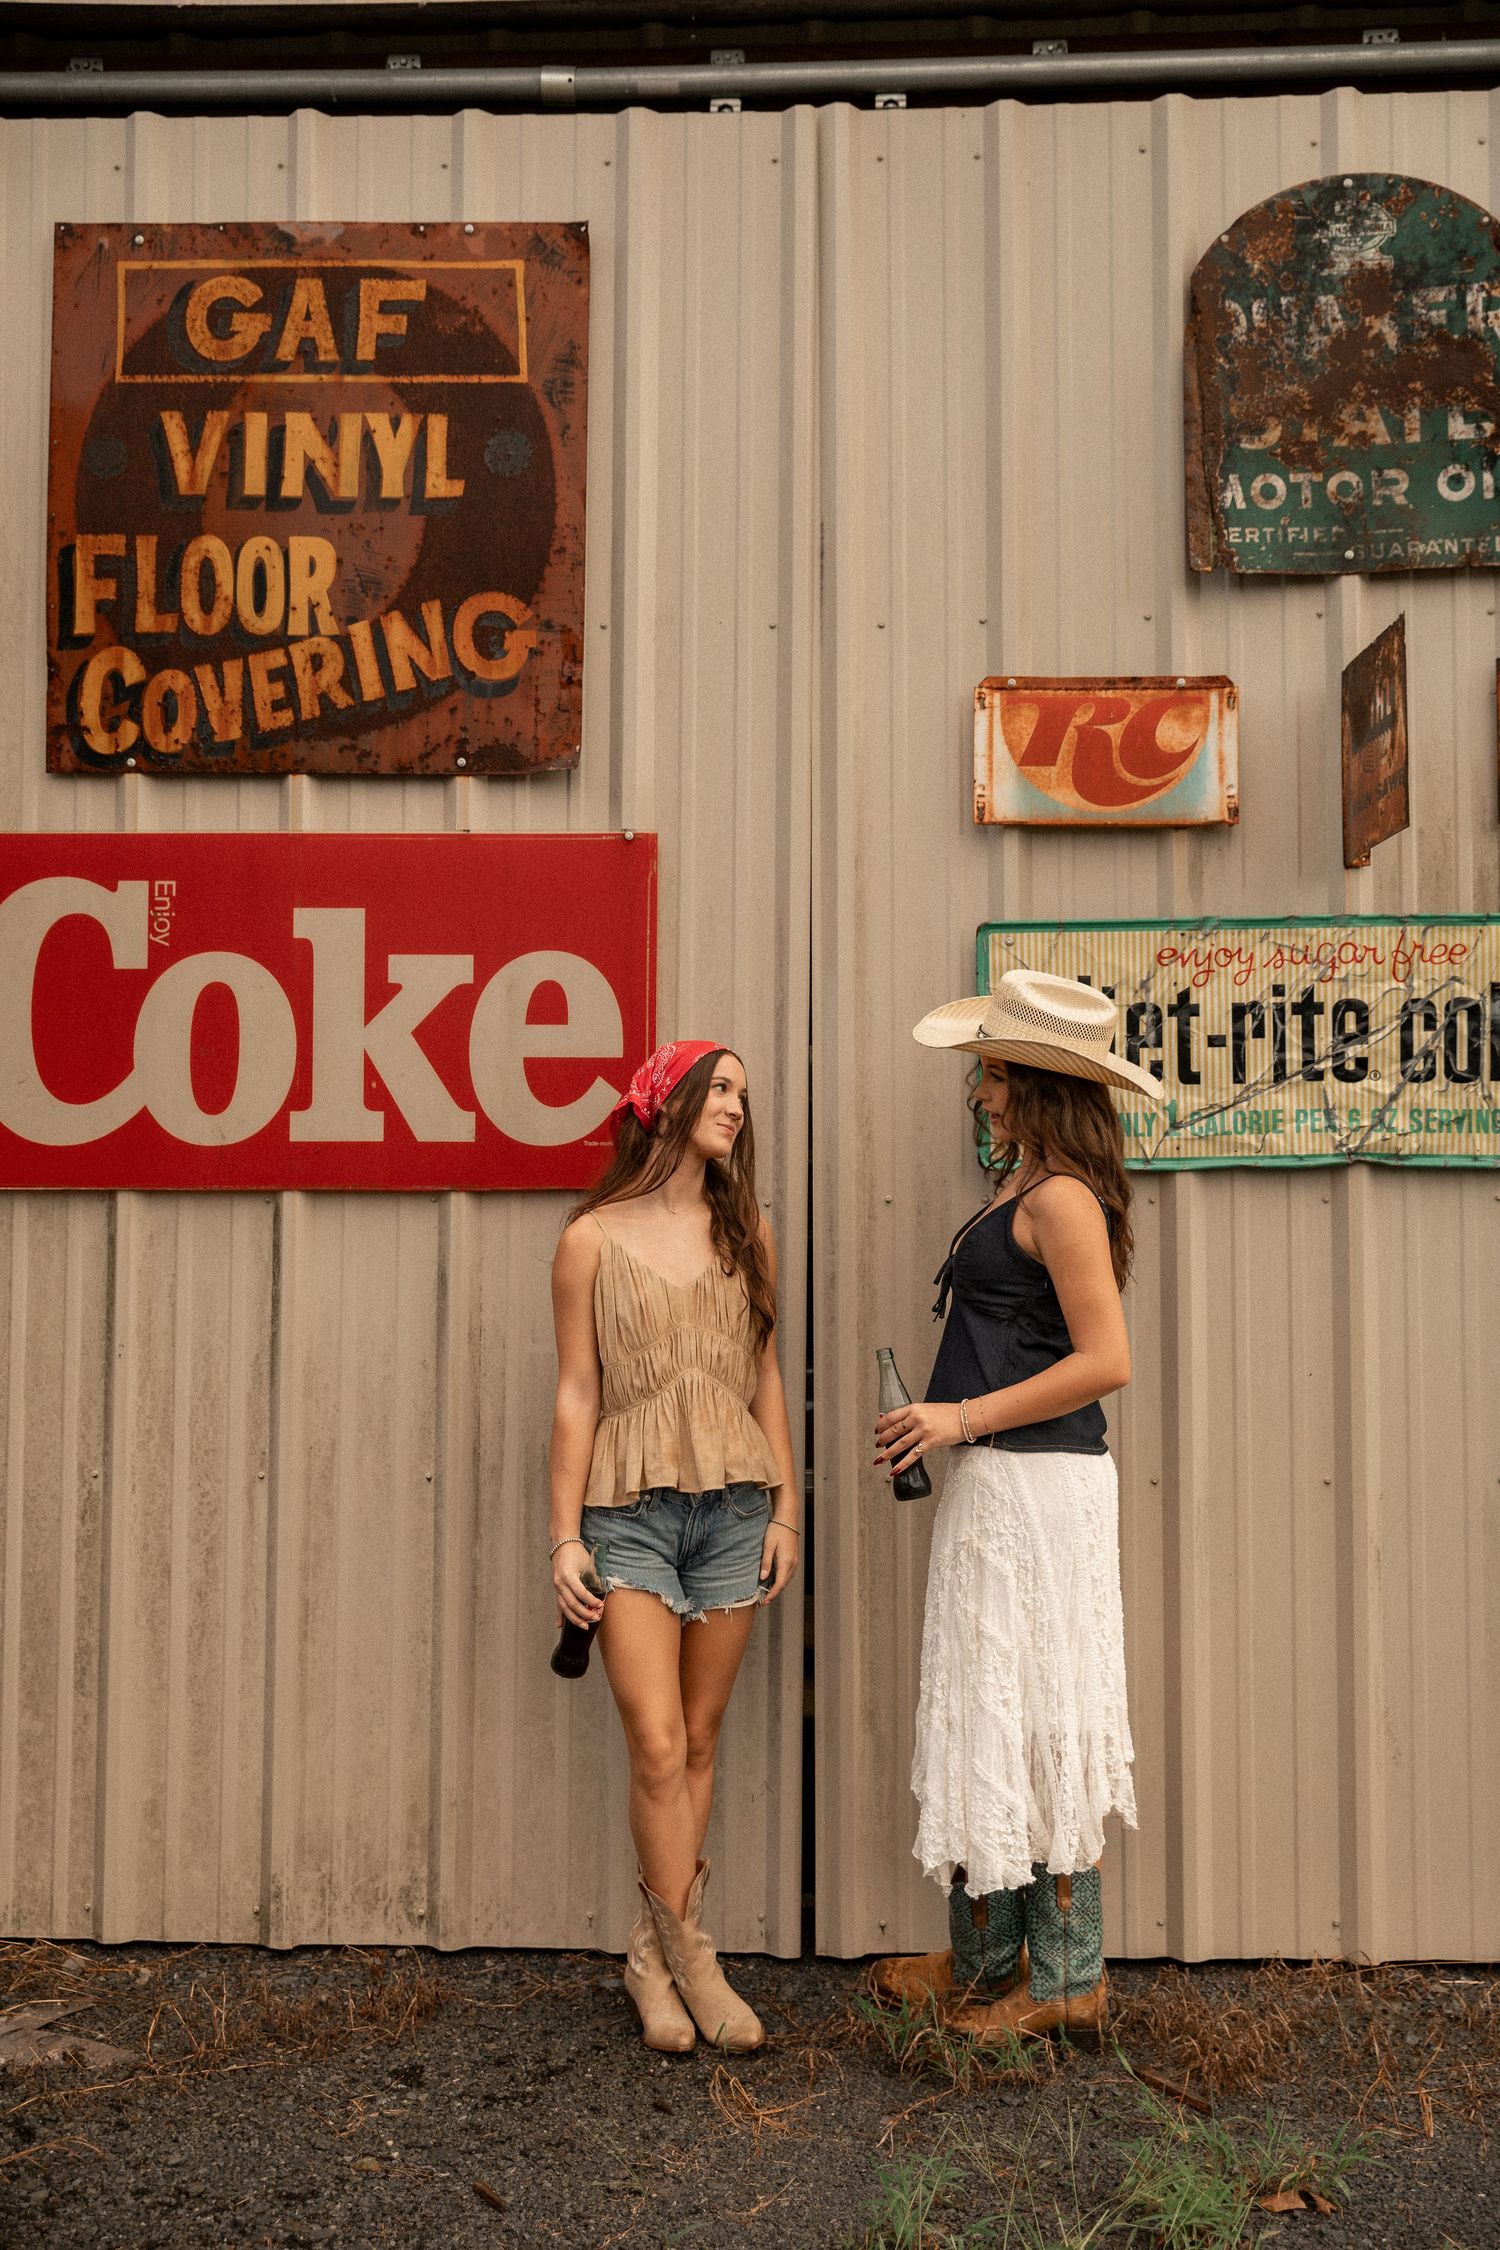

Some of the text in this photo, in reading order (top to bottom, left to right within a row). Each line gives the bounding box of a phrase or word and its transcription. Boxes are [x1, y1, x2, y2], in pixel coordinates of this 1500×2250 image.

[185, 275, 427, 362] GAF
[160, 410, 466, 499] VINYL
[71, 533, 341, 638] FLOOR
[79, 591, 537, 755] COVERING
[1005, 698, 1203, 807] RC
[149, 880, 177, 947] Enjoy
[1156, 930, 1467, 988] enjoy sugar free
[0, 876, 624, 1147] Coke
[1077, 975, 1369, 1084] et-rite
[1119, 1111, 1157, 1138] NLY
[1163, 1099, 1182, 1137] 1
[1189, 1108, 1284, 1138] CALORIE
[1347, 1108, 1361, 1133] 6
